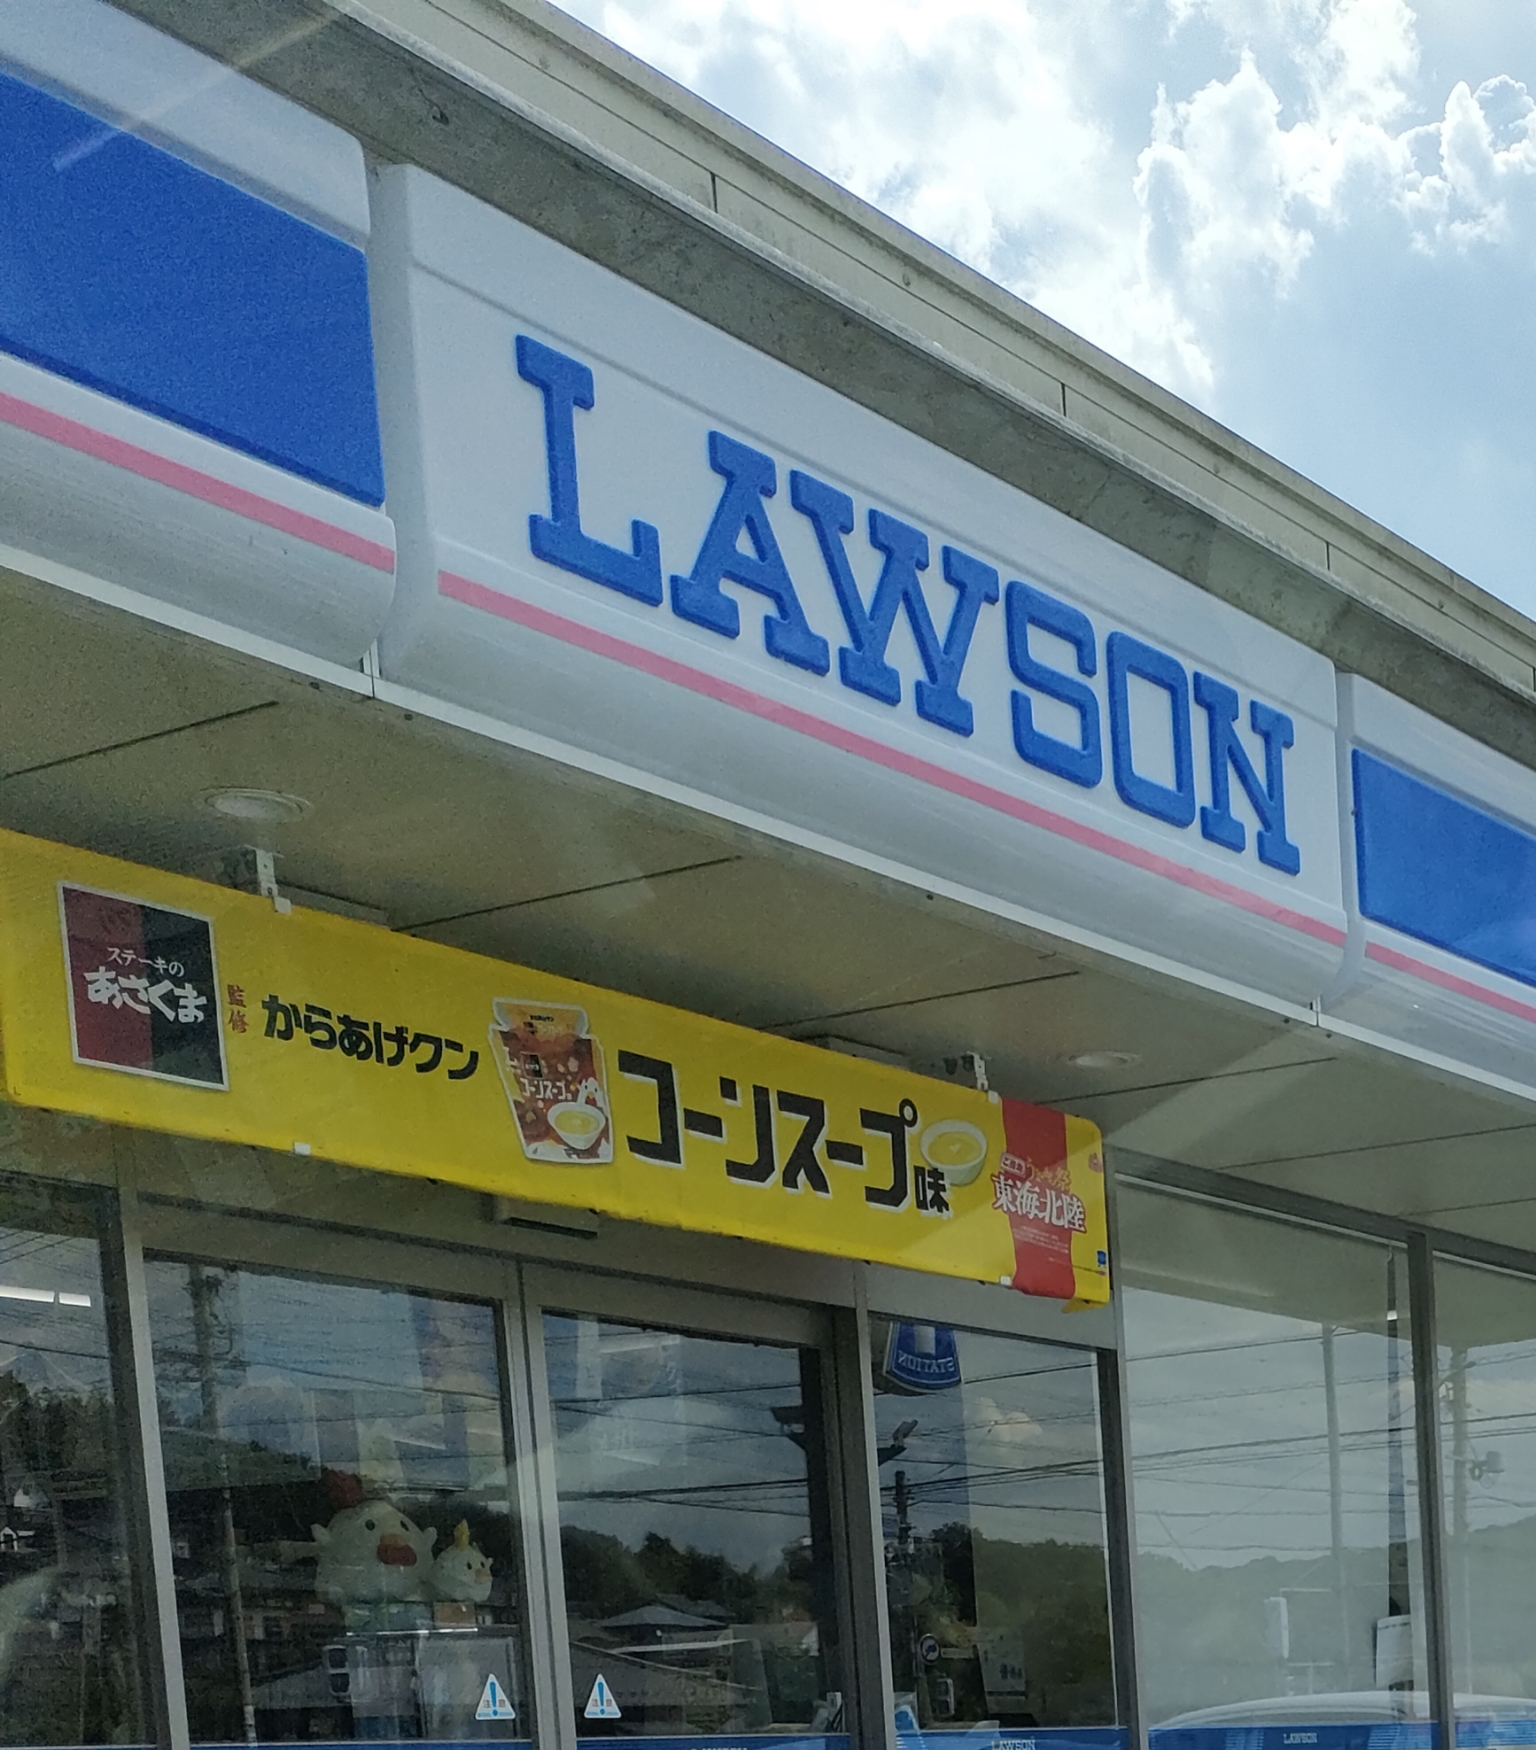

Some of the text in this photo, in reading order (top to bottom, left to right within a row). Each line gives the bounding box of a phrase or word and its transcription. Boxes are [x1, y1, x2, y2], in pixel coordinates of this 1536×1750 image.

[514, 334, 1301, 876] LAWSON
[85, 966, 207, 1023] あさくま
[107, 947, 185, 977] ステーキの
[262, 994, 479, 1080] からあげクン
[618, 1049, 951, 1213] コーンスープ味
[992, 1174, 1086, 1231] 東海北陸
